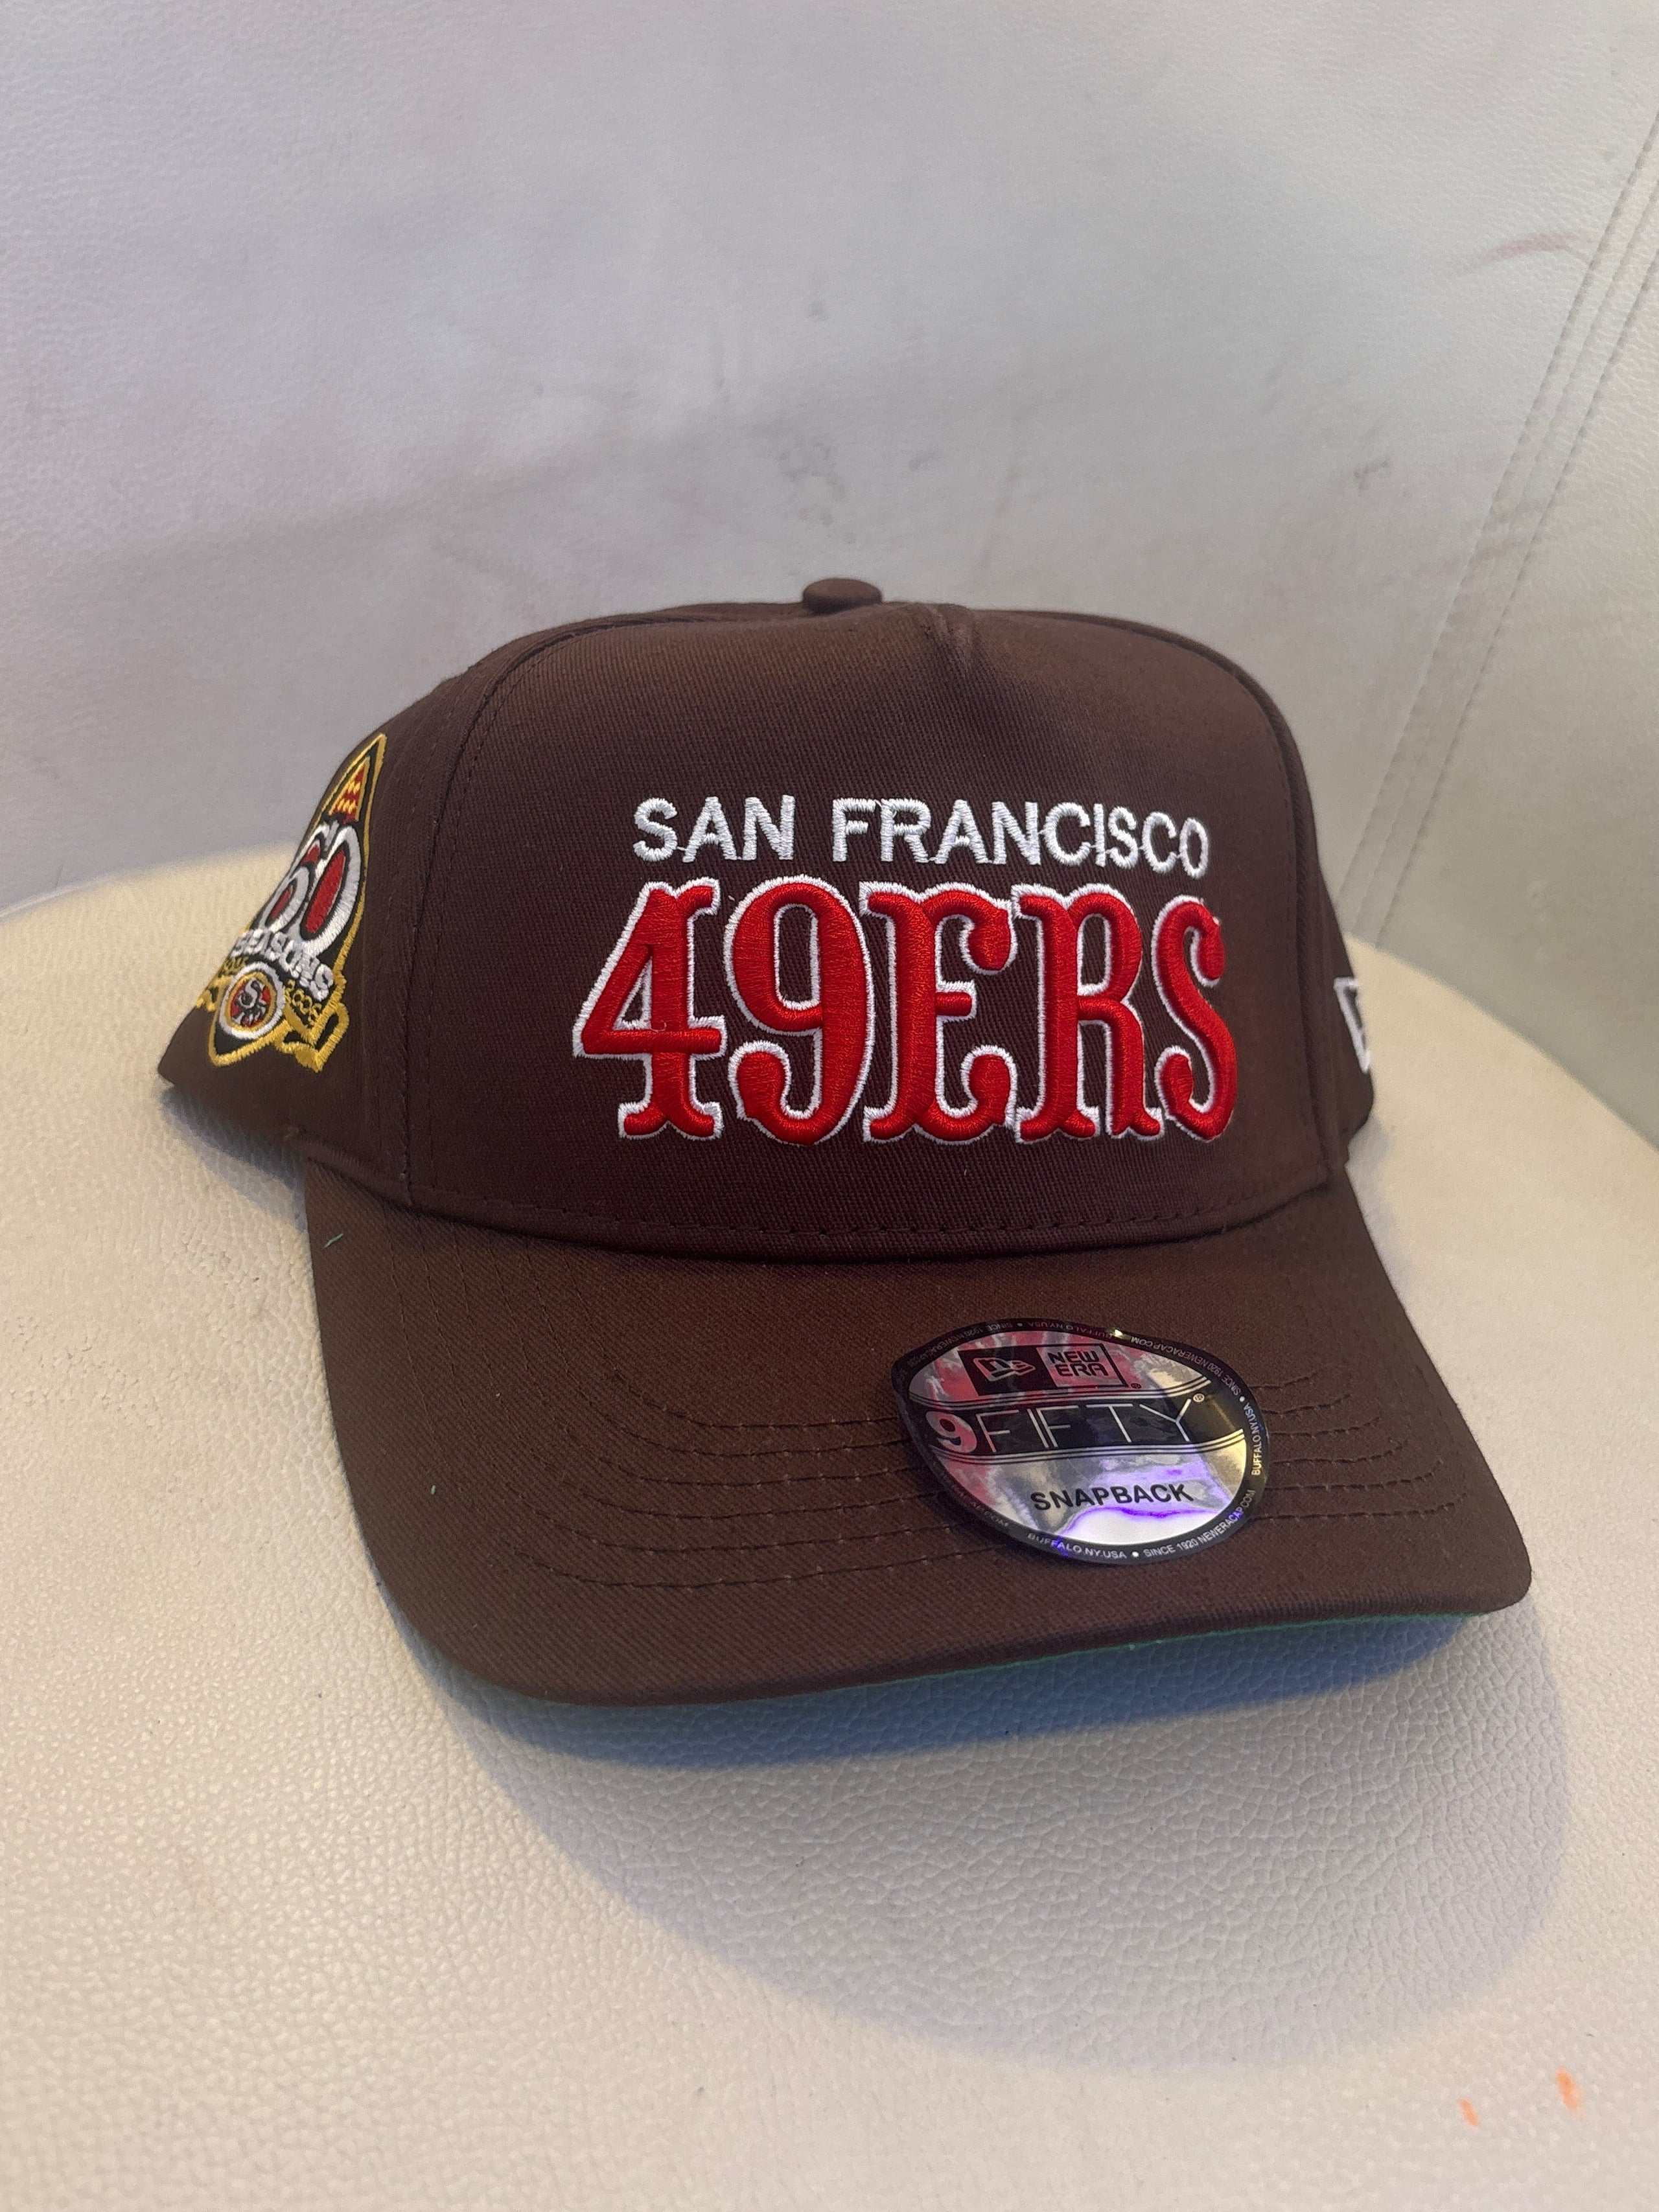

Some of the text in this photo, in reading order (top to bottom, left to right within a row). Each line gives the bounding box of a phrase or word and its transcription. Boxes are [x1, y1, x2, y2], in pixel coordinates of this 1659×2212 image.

[633, 794, 1209, 879] SAN FRANCISCO
[257, 819, 362, 958] 60
[573, 873, 1238, 1147] 49ERS
[1048, 1350, 1100, 1364] NEW
[1056, 1363, 1109, 1377] ERA
[1030, 1483, 1195, 1512] SNAPBACK
[1102, 1550, 1128, 1560] USA
[1143, 1545, 1176, 1558] SINCE
[1177, 1538, 1199, 1551] 1920
